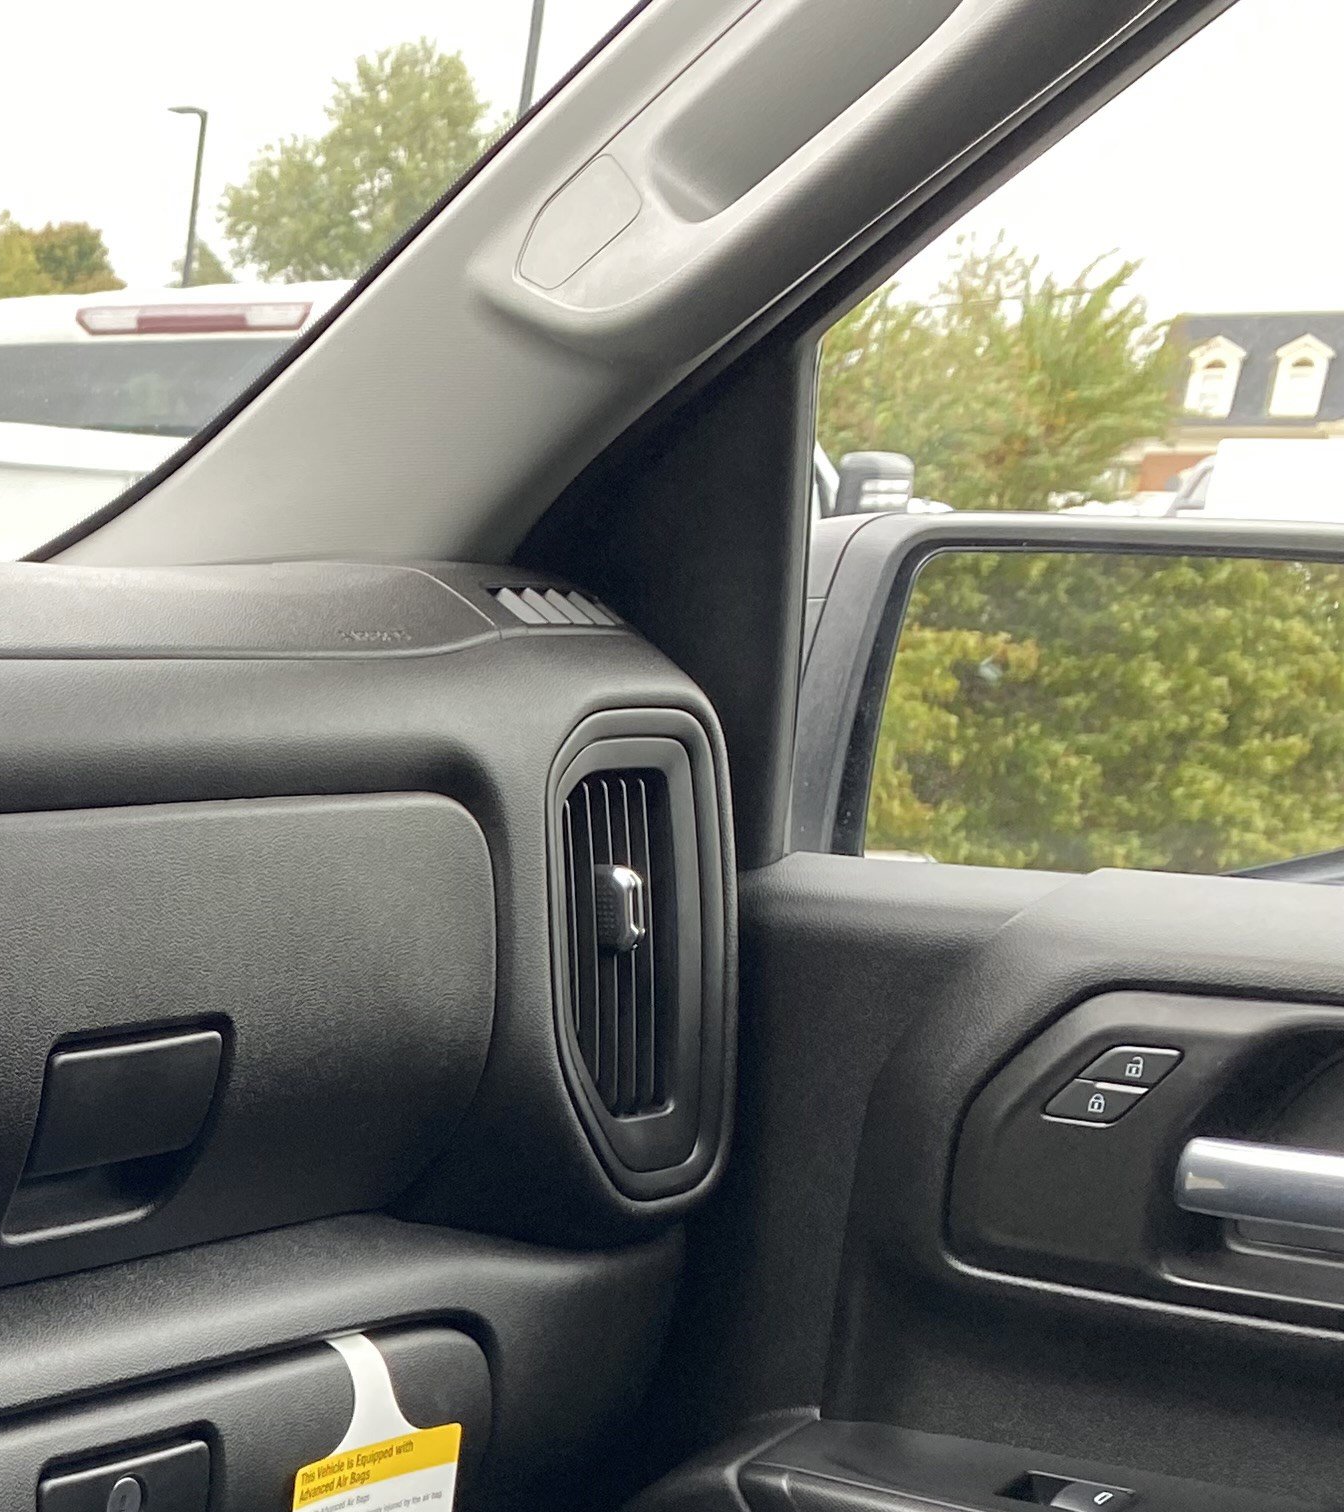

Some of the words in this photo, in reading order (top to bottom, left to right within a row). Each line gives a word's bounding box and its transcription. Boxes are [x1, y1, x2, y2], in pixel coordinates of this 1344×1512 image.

[301, 1471, 315, 1486] This
[318, 1460, 344, 1478] Vehicle
[347, 1458, 353, 1470] is
[356, 1445, 394, 1468] Equipped
[396, 1440, 414, 1455] with
[300, 1479, 334, 1503] Advanced
[336, 1475, 347, 1489] Air
[350, 1470, 371, 1486] Bags
